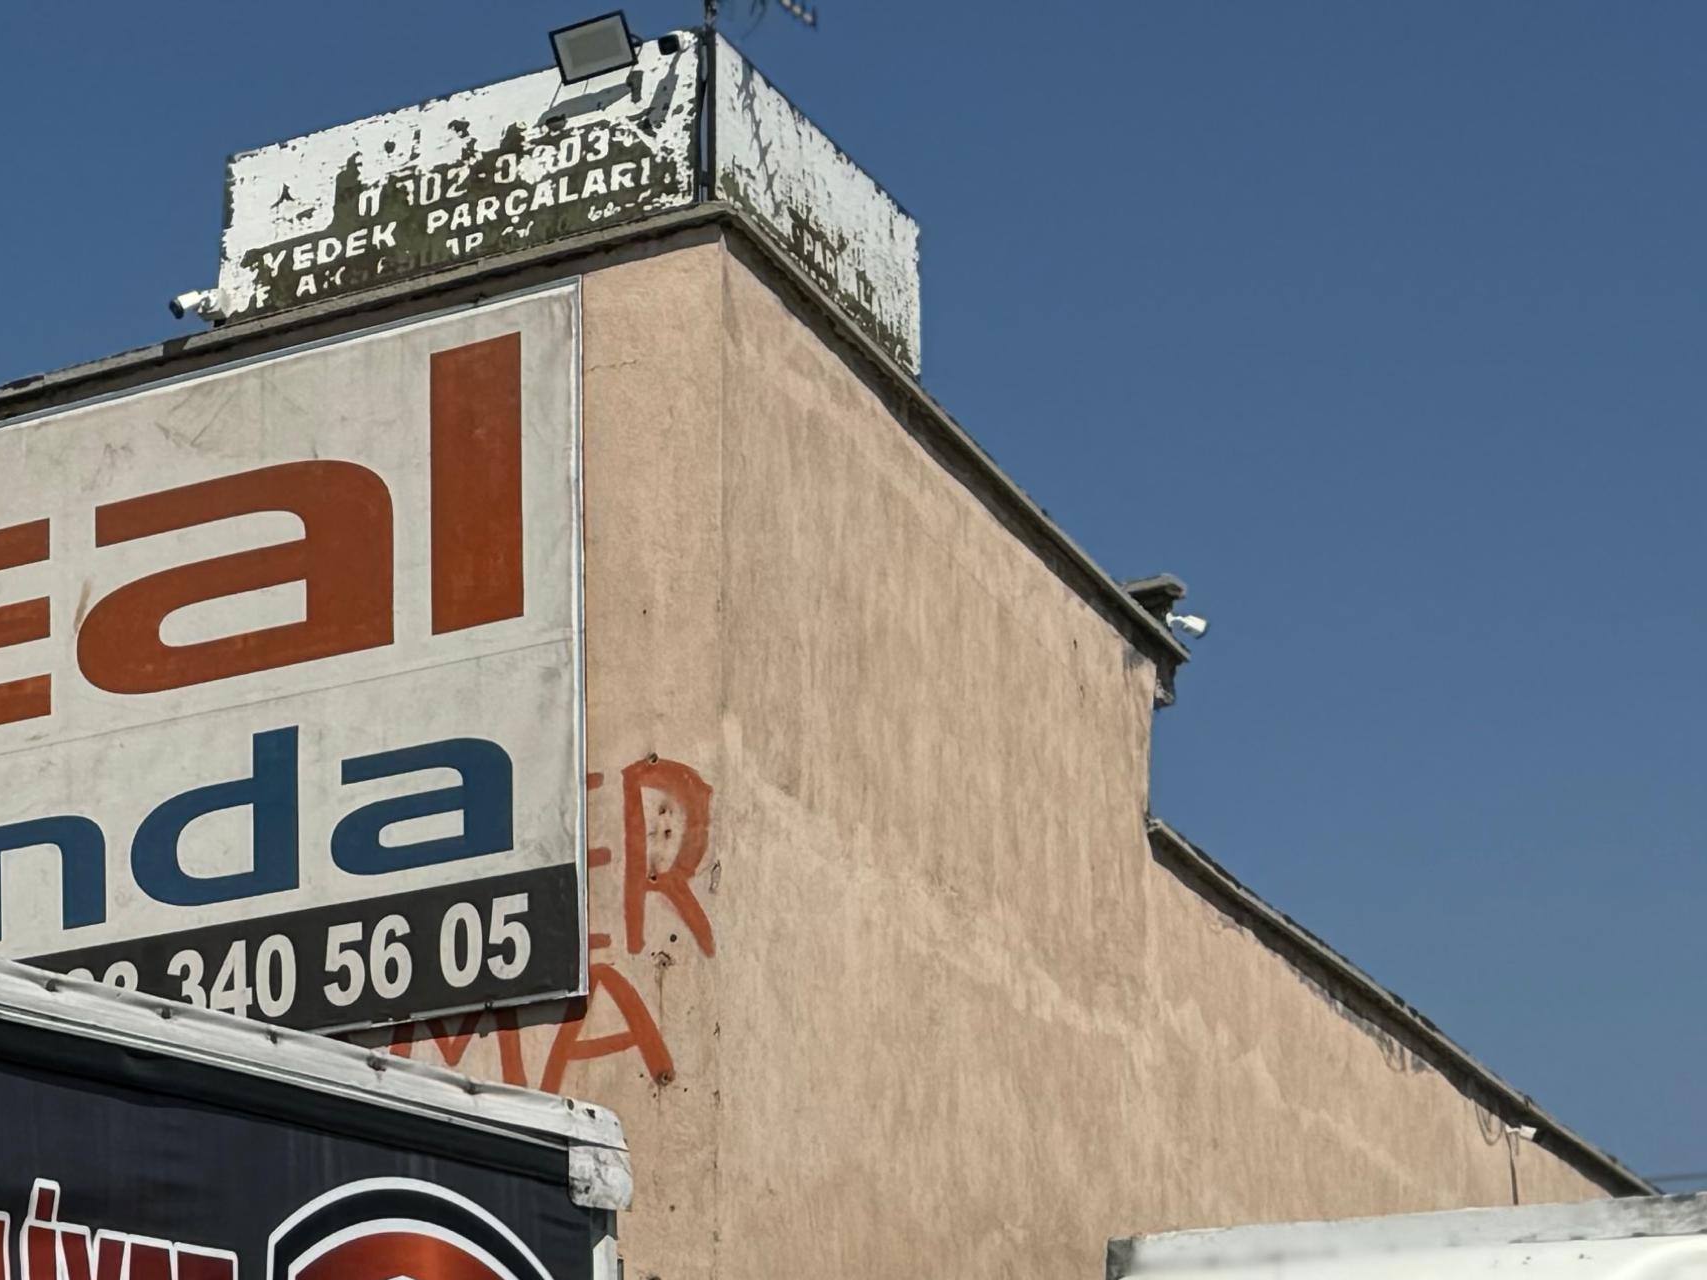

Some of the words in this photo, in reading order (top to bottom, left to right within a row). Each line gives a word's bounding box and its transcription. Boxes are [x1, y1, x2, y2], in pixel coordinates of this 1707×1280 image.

[264, 220, 398, 277] YEDEK
[426, 157, 651, 235] PARÇALARI
[181, 935, 297, 1018] 340
[324, 912, 413, 1005] 56
[440, 892, 531, 989] 05
